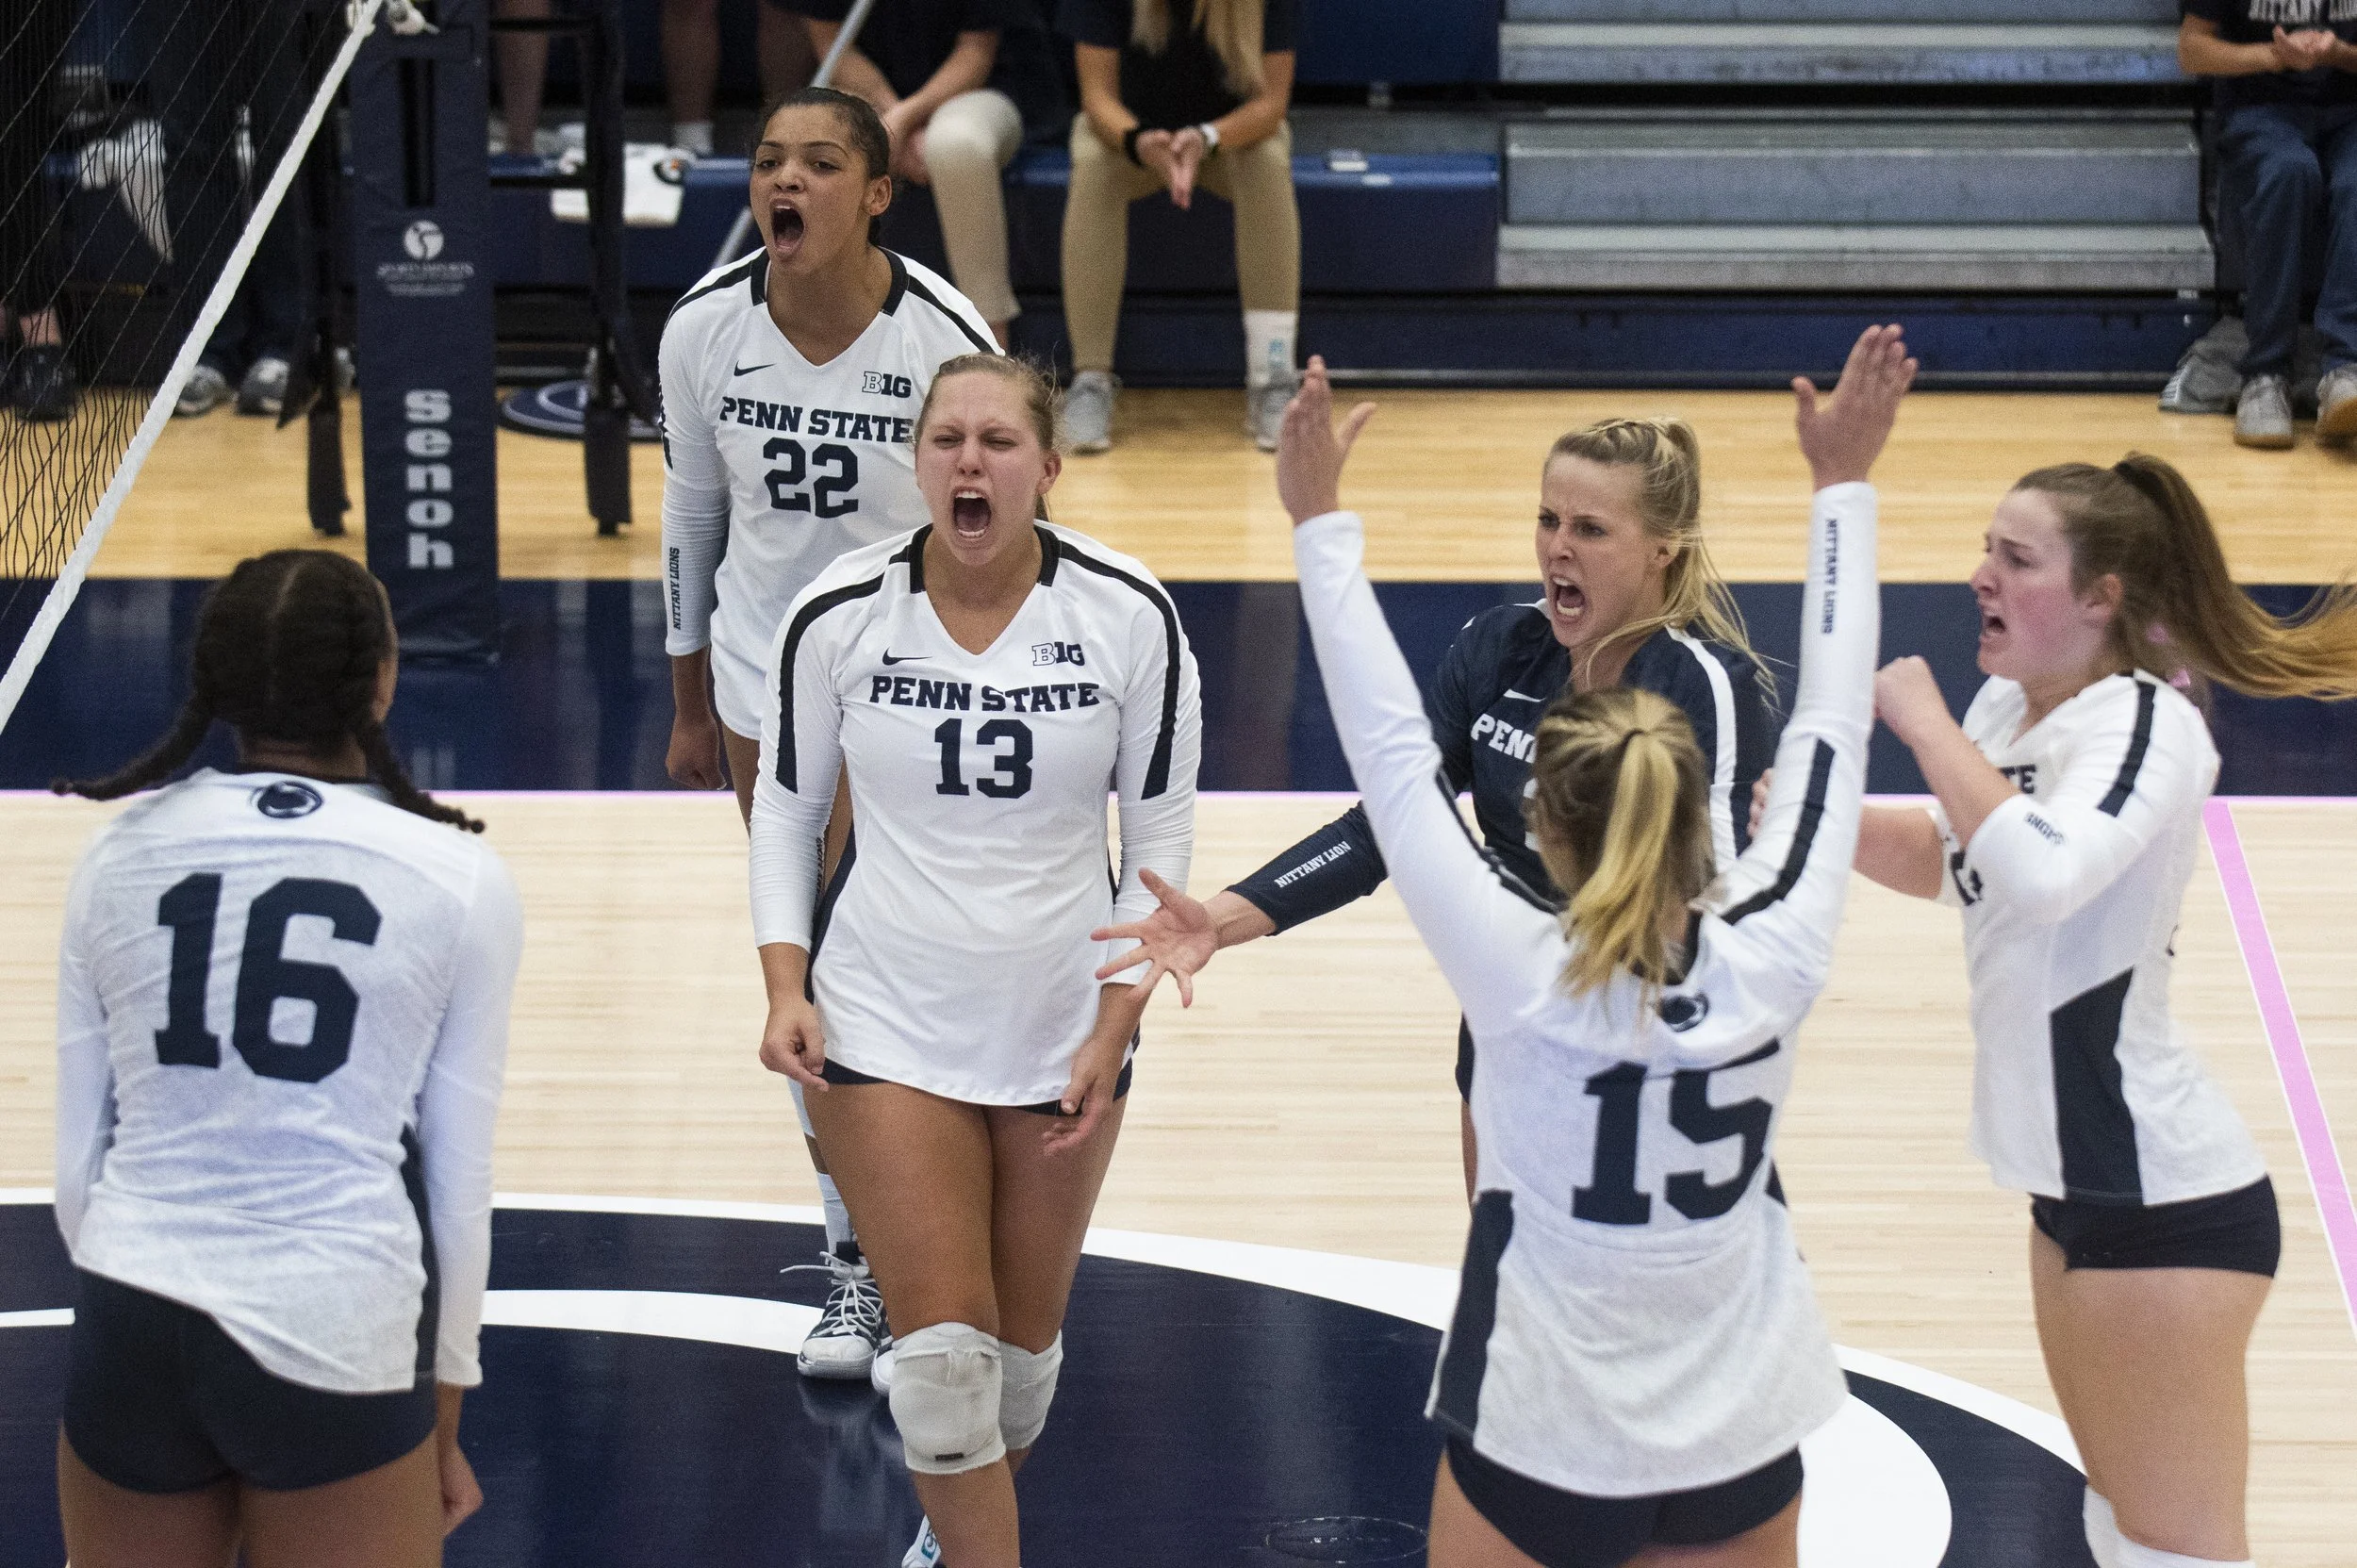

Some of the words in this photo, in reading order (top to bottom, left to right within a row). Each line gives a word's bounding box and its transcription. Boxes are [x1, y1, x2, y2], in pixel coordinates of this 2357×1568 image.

[719, 396, 803, 433] PENN
[808, 408, 915, 443] STATE
[763, 437, 859, 519] 22
[669, 547, 680, 580] LIONS
[1825, 520, 1838, 585] NITTANY
[670, 581, 681, 630] NITTANY
[869, 675, 972, 711] PENN
[981, 682, 1100, 712] STATE
[934, 718, 1033, 799] 13
[1274, 854, 1327, 888] NITTANY
[155, 872, 382, 1083] 16
[1571, 1036, 1780, 1226] 15
